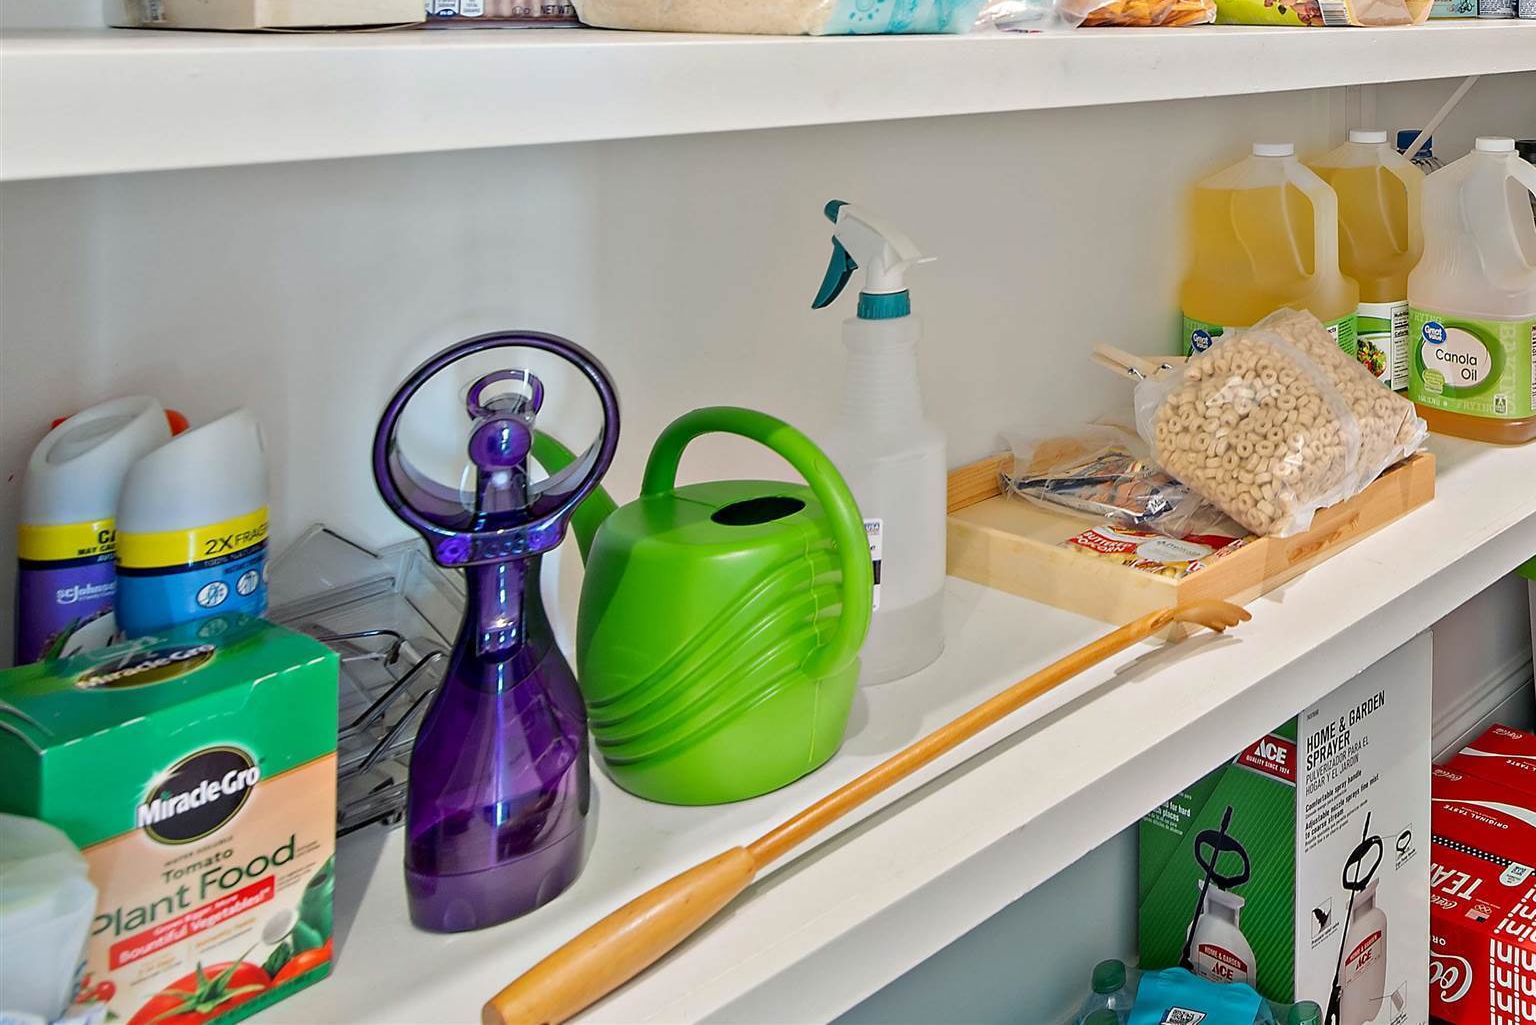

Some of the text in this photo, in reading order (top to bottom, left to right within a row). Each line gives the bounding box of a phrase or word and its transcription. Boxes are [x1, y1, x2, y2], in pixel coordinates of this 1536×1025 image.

[540, 5, 557, 15] NET
[1424, 326, 1443, 336] Great
[1435, 348, 1478, 366] Canola
[1461, 368, 1478, 382] Oil
[204, 534, 234, 556] 2X
[1306, 689, 1386, 754] HOME & GARDEN
[1254, 738, 1288, 765] ACE
[1306, 730, 1351, 772] SPRAYER
[1246, 755, 1278, 771] QUALITY SINCE
[1305, 739, 1362, 786] PULVERIZADOR PARA
[1505, 759, 1530, 770] TASTE
[136, 764, 261, 829] Miracle-Gro
[1305, 778, 1326, 796] HOGAR
[1305, 769, 1363, 813] Comfortable handle
[1162, 809, 1180, 822] places
[1178, 804, 1191, 817] hard
[1305, 786, 1360, 831] Adjustable sprays
[1443, 804, 1468, 816] TASTE
[1311, 807, 1345, 837] coarse stream
[1471, 813, 1509, 830] ORIGINAL
[161, 848, 234, 884] Tomato
[200, 834, 297, 900] Food
[118, 927, 188, 964] Bountiful
[1355, 948, 1373, 971] ACE
[1211, 961, 1235, 981] ACE
